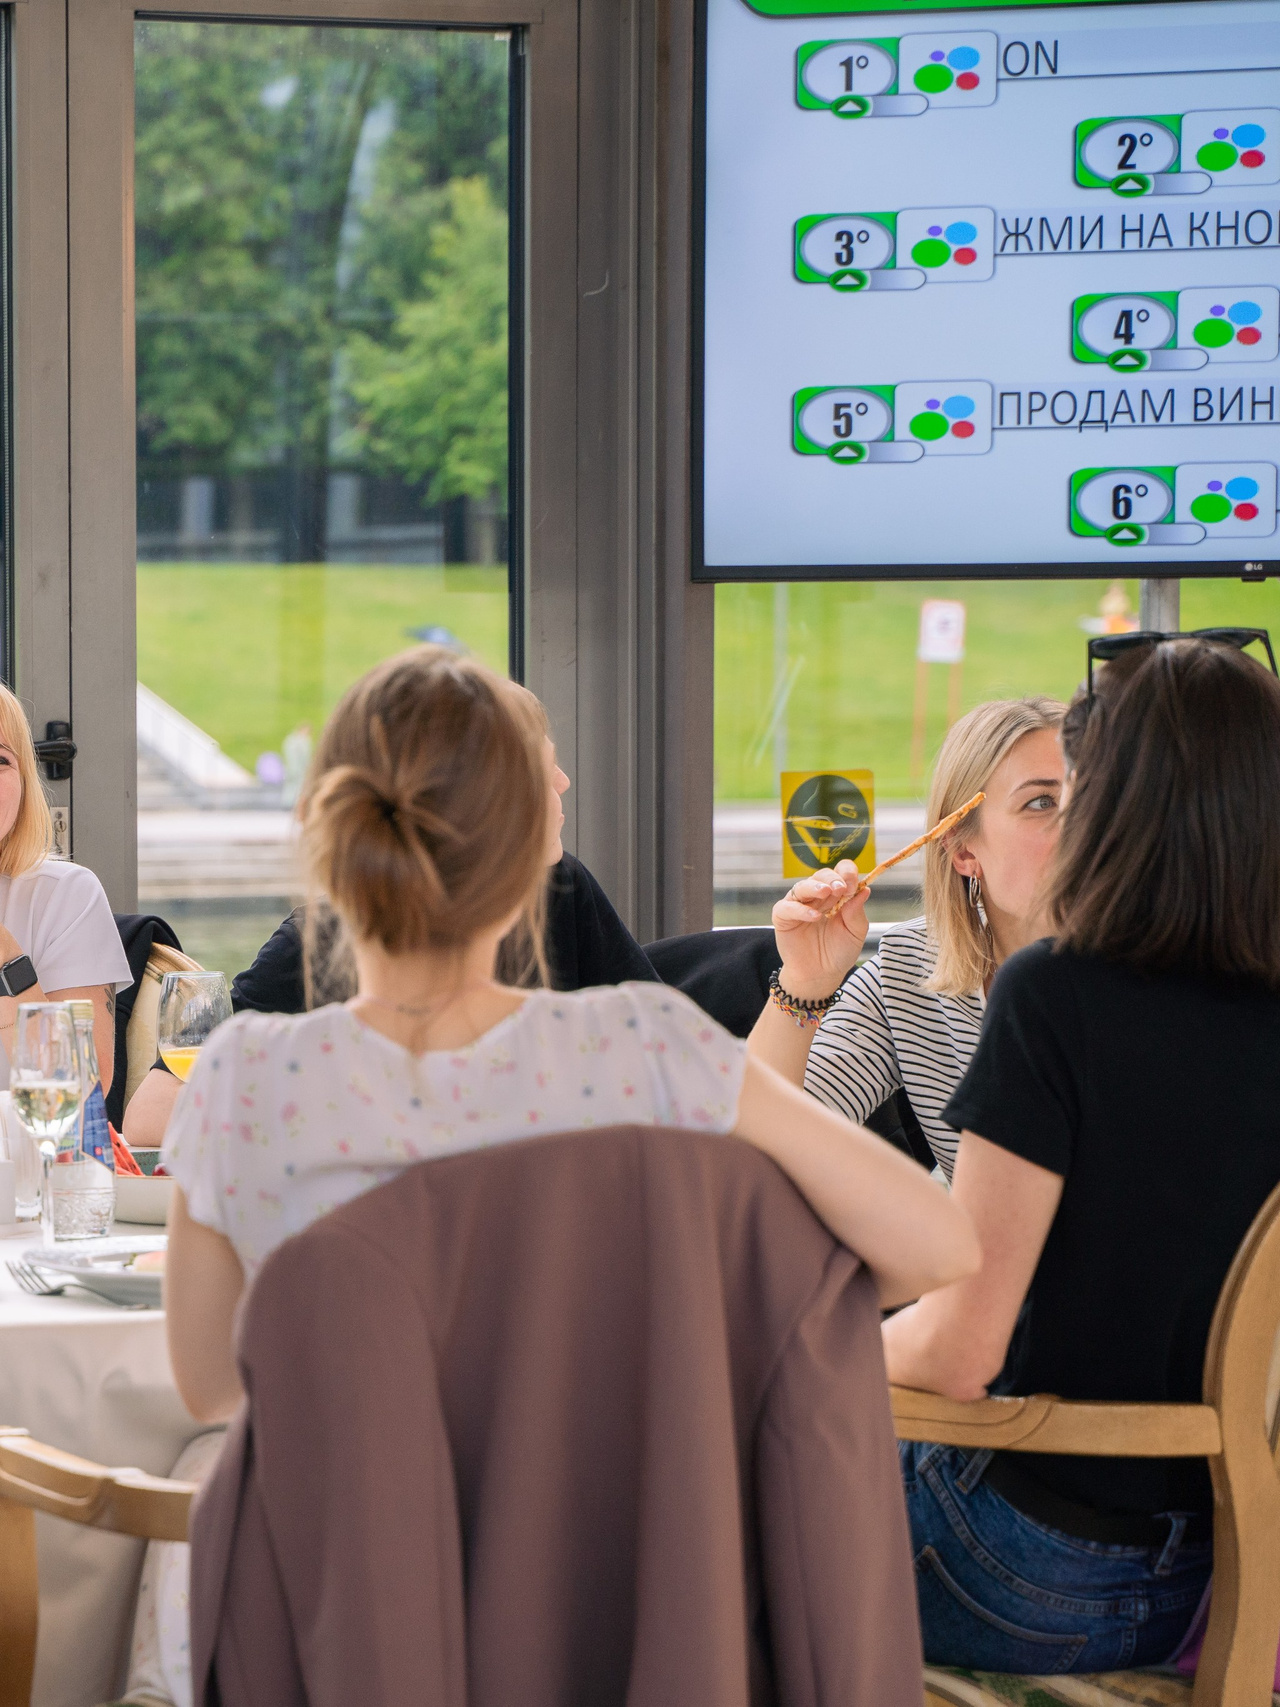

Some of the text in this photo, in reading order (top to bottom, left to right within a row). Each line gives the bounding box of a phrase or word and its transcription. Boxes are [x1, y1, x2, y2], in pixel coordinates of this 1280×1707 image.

[1002, 40, 1059, 76] ON
[999, 214, 1104, 252] ЖМИ
[1120, 213, 1174, 249] НА
[1189, 209, 1280, 247] КНО
[999, 388, 1176, 432] ПРОДАМ
